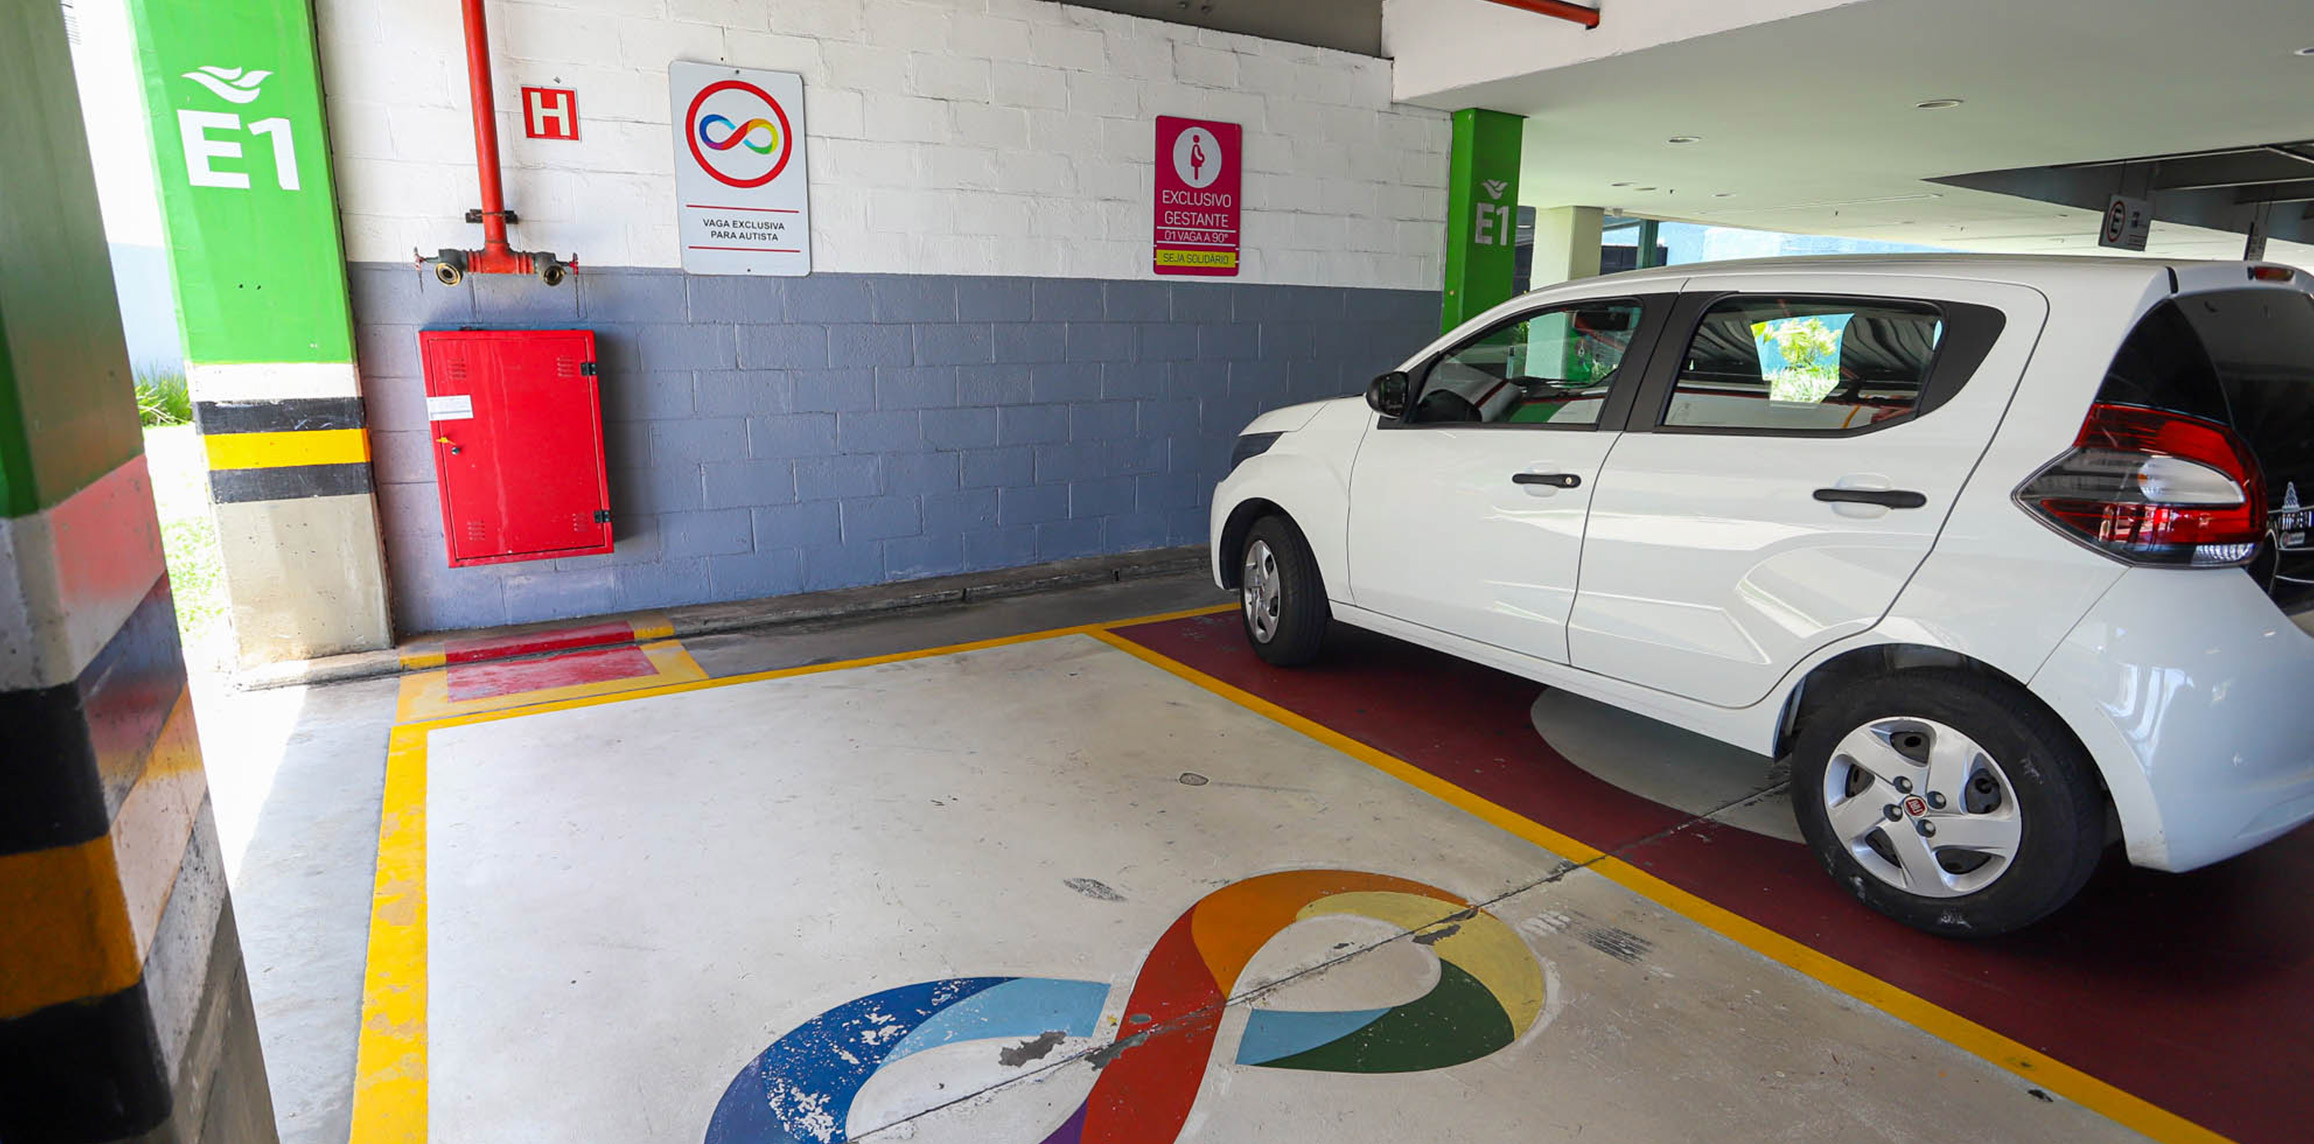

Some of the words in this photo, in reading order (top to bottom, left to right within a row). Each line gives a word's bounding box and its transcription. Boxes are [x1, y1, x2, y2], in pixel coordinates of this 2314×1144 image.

[530, 91, 571, 136] H
[177, 109, 301, 190] E1
[1162, 189, 1232, 208] EXCLUSIVO
[702, 218, 730, 228] VAGA
[732, 219, 786, 231] EXCLUSIVA
[1164, 210, 1229, 228] GESTANTE
[1475, 202, 1510, 246] E1
[710, 230, 737, 240] PARA
[738, 231, 779, 241] AUTISTA
[1164, 230, 1176, 241] 01
[1177, 231, 1203, 242] VAGA
[1203, 232, 1211, 242] A
[1163, 252, 1185, 263] SEJA
